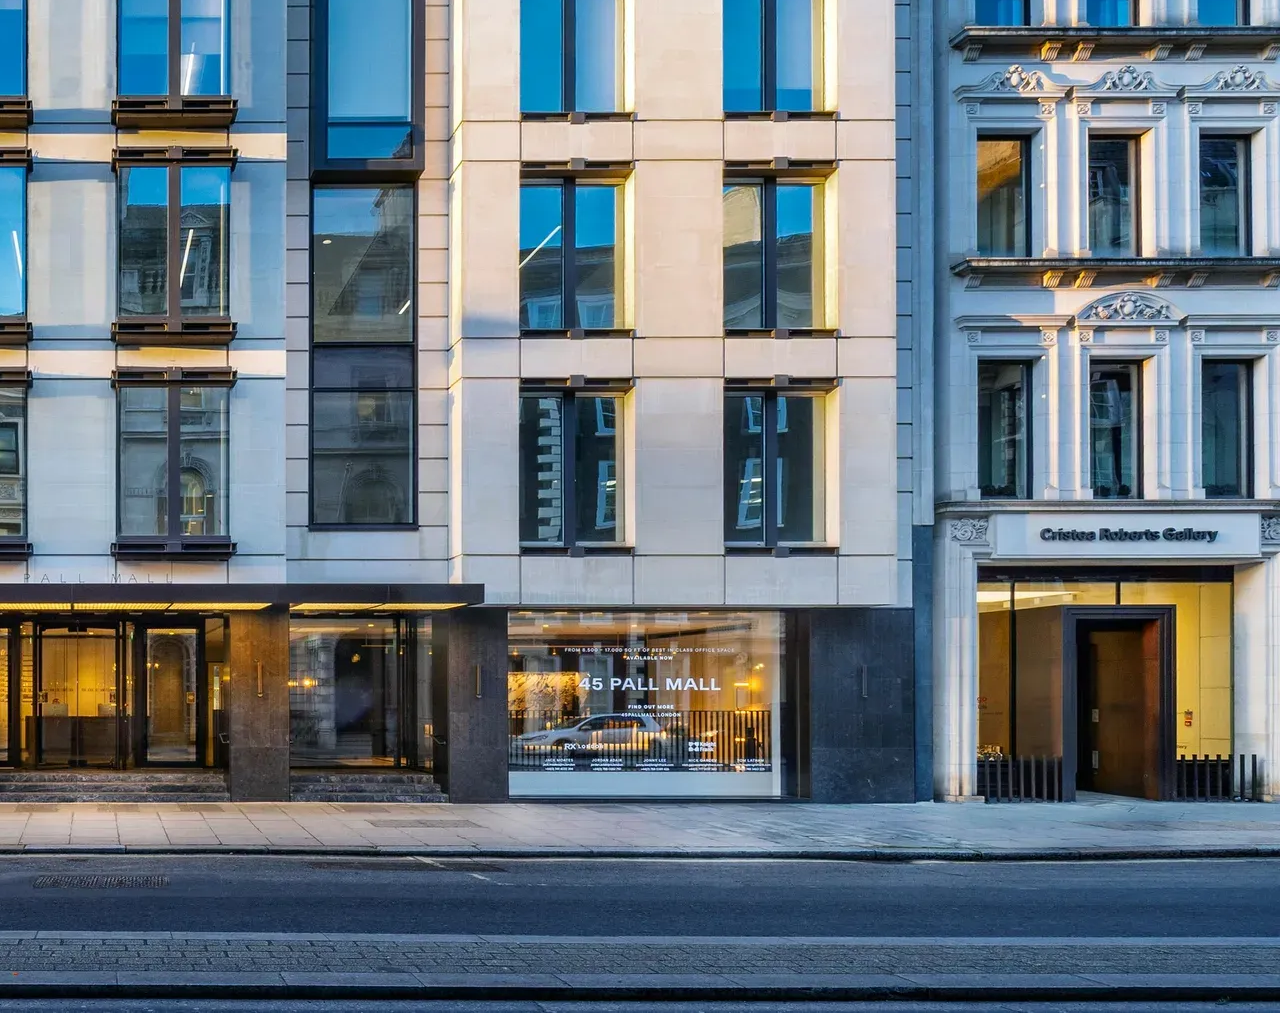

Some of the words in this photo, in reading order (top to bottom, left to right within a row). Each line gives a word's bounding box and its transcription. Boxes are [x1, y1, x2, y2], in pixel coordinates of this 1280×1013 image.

[1039, 527, 1096, 542] Cristea
[1099, 527, 1161, 542] Roberts
[1162, 527, 1219, 543] Gallery
[23, 573, 86, 584] PALL
[111, 573, 173, 584] MALL
[578, 677, 603, 691] 45
[610, 677, 659, 691] PALL
[665, 677, 721, 691] MALL
